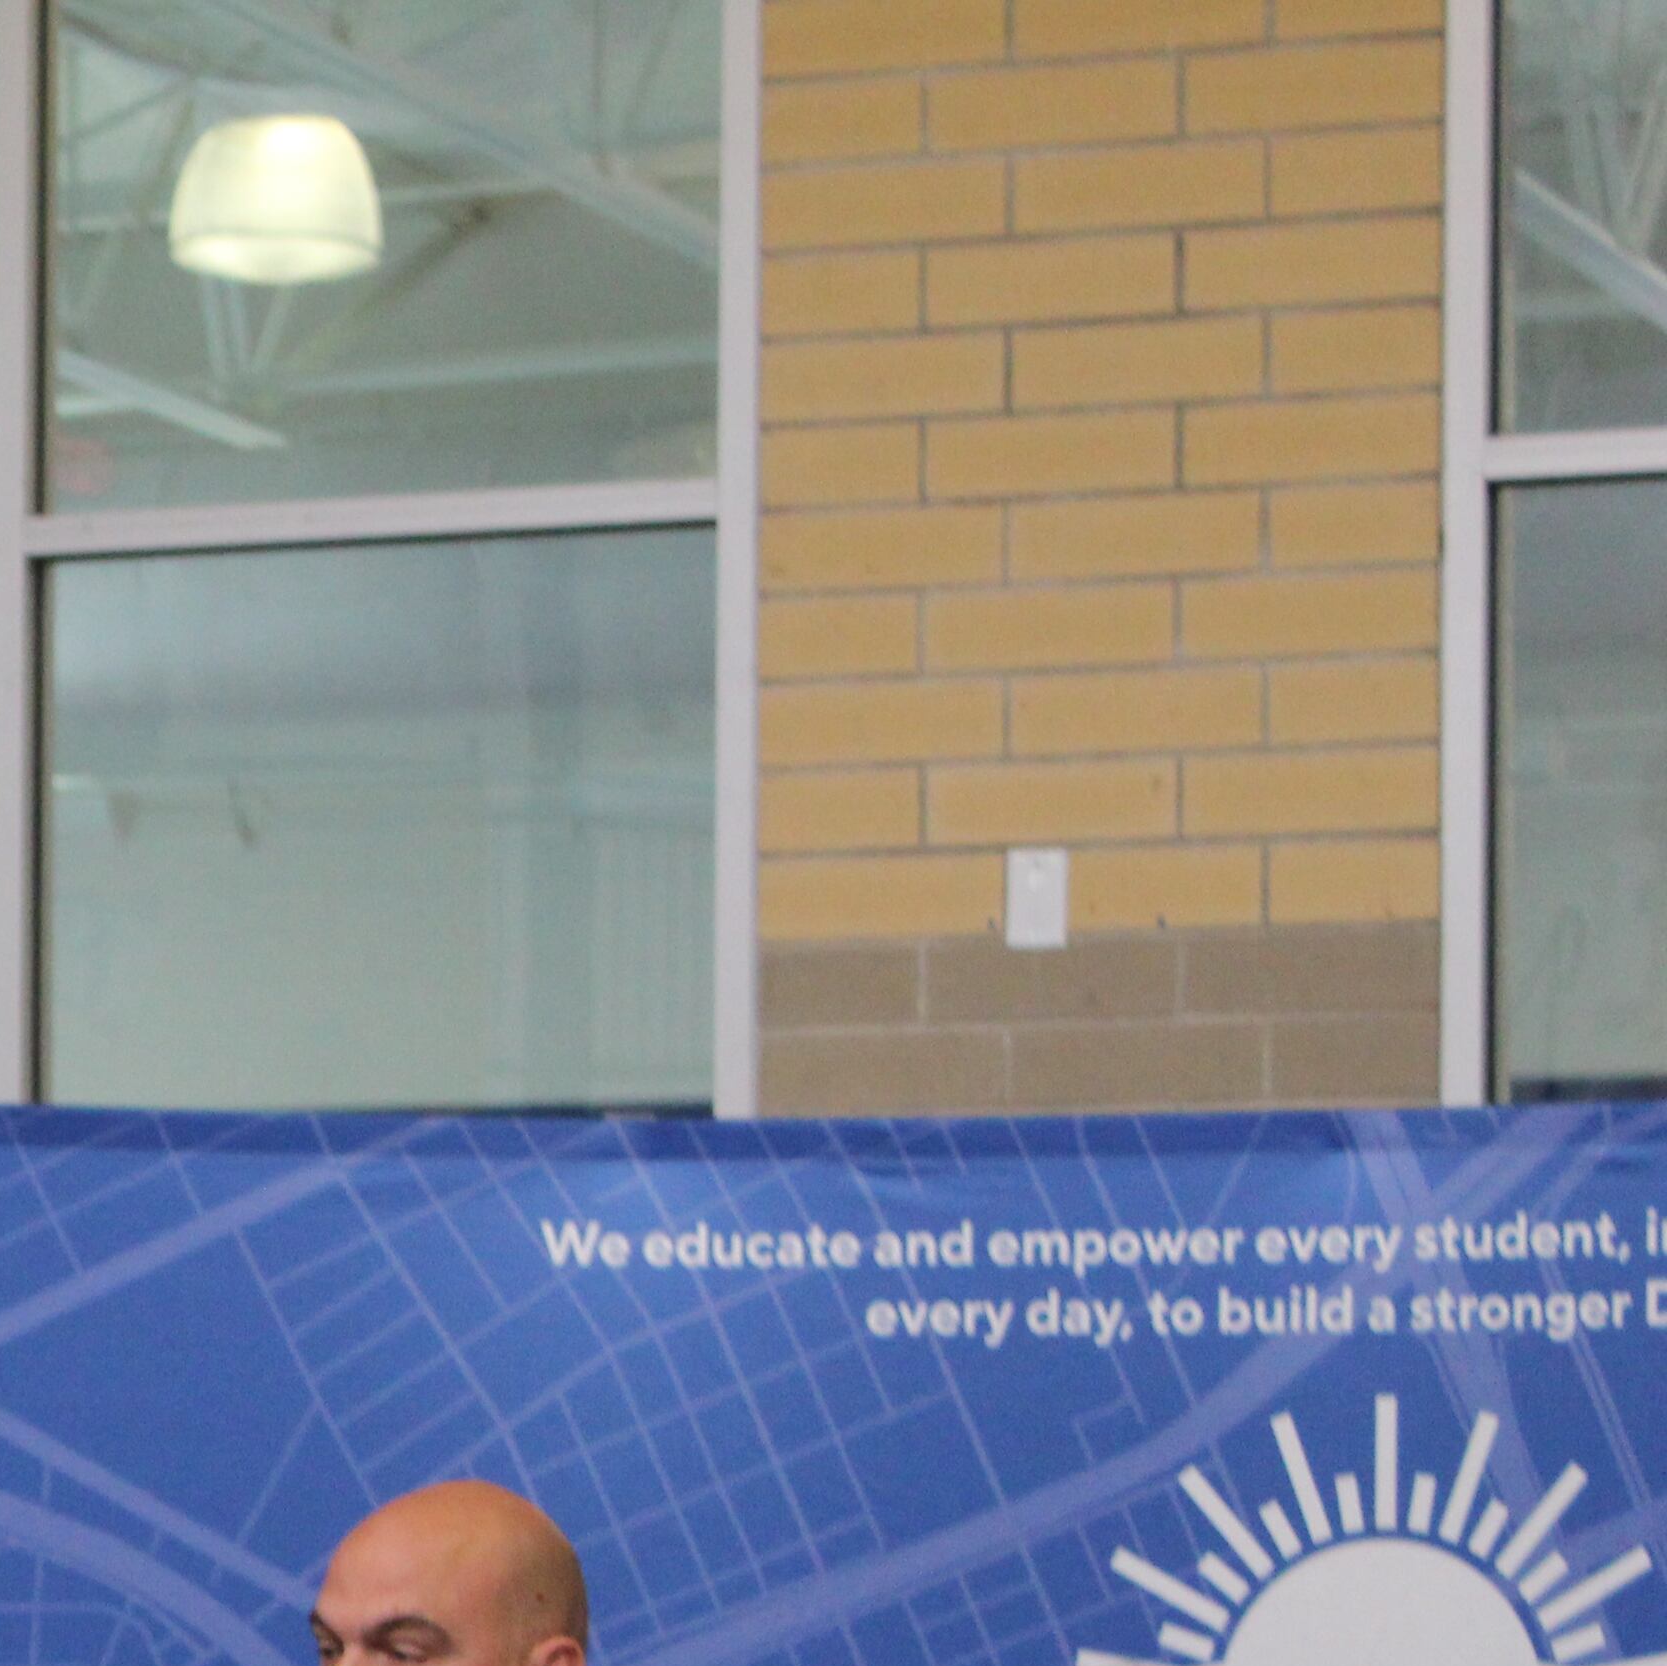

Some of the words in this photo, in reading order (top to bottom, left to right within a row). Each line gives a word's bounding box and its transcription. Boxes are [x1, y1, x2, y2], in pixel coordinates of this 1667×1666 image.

[543, 1220, 630, 1268] We
[643, 1218, 860, 1268] educate
[874, 1217, 975, 1268] and
[988, 1225, 1243, 1277] empower
[1255, 1225, 1402, 1275] every
[1414, 1208, 1632, 1265] student,
[868, 1296, 1013, 1346] every
[1025, 1287, 1134, 1344] day,
[1148, 1291, 1205, 1336] to
[1219, 1284, 1354, 1335] build
[1367, 1293, 1397, 1334] a
[1410, 1287, 1633, 1342] stronger
